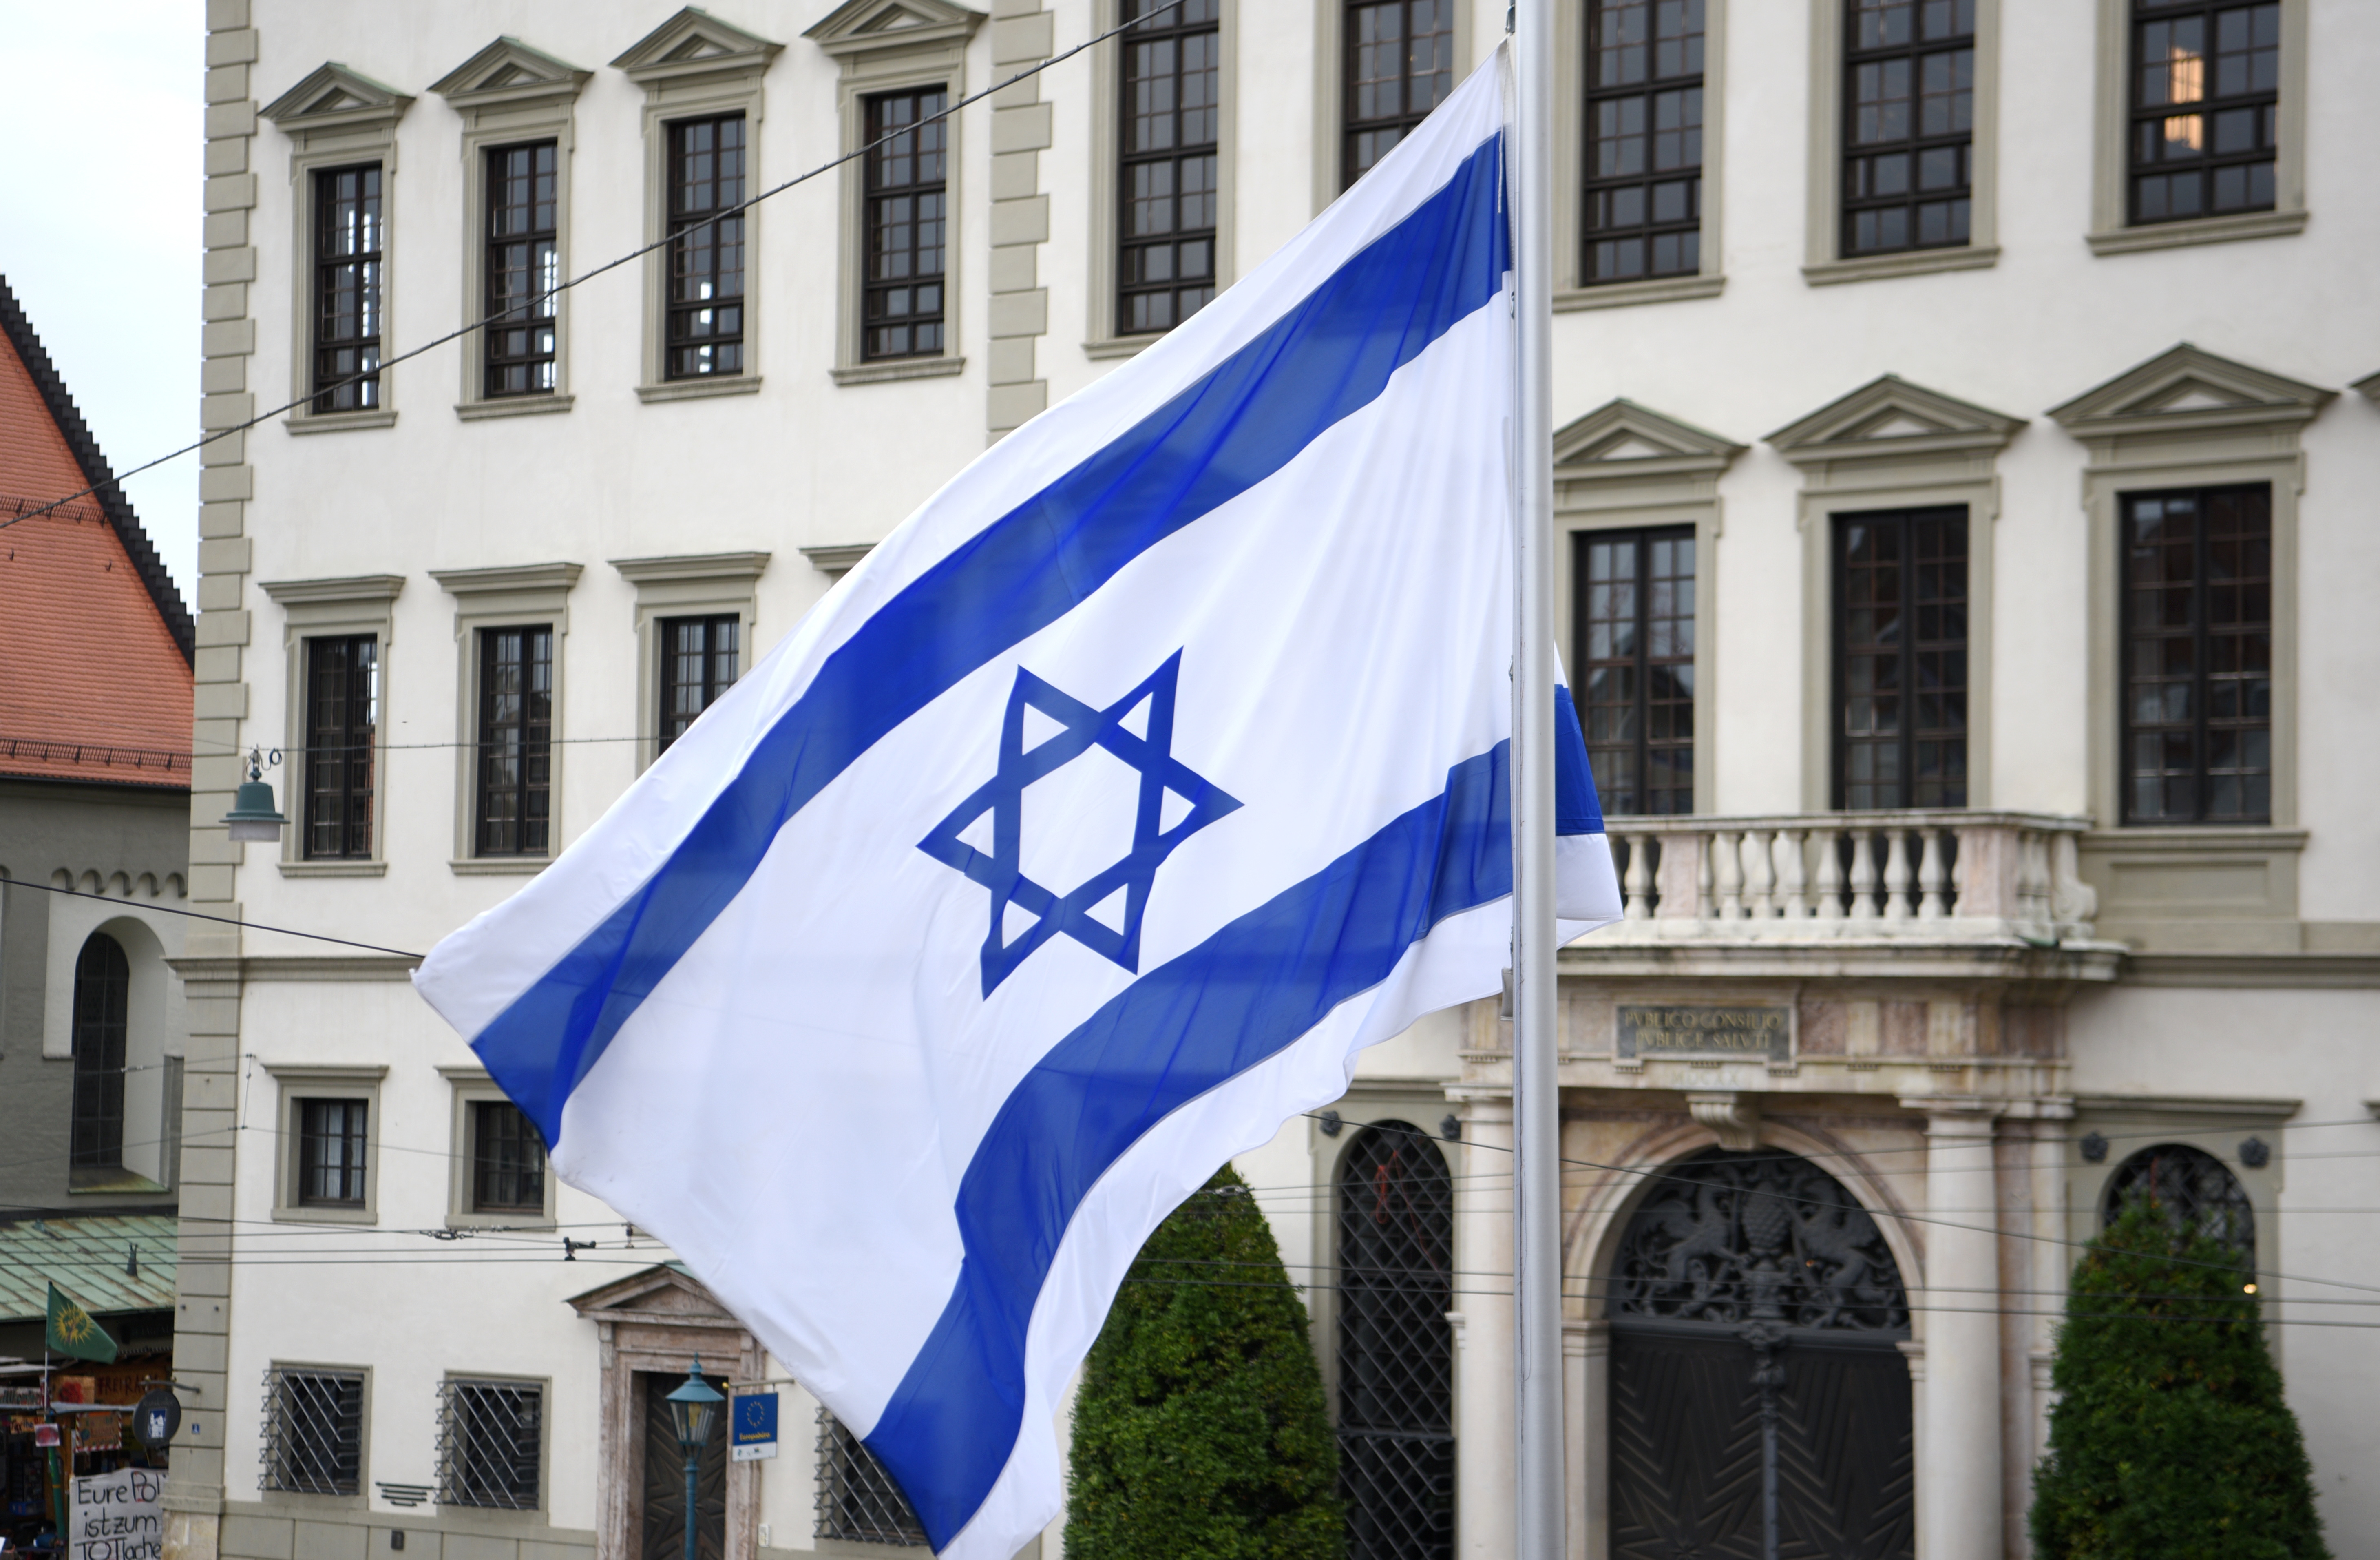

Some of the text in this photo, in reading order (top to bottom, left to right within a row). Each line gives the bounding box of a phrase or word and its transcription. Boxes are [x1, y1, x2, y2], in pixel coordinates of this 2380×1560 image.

[1625, 1011, 1781, 1031] PVBLICO CONSILIO
[740, 1432, 770, 1441] Europabüro
[77, 1478, 128, 1504] Eure
[84, 1507, 157, 1538] ist zum
